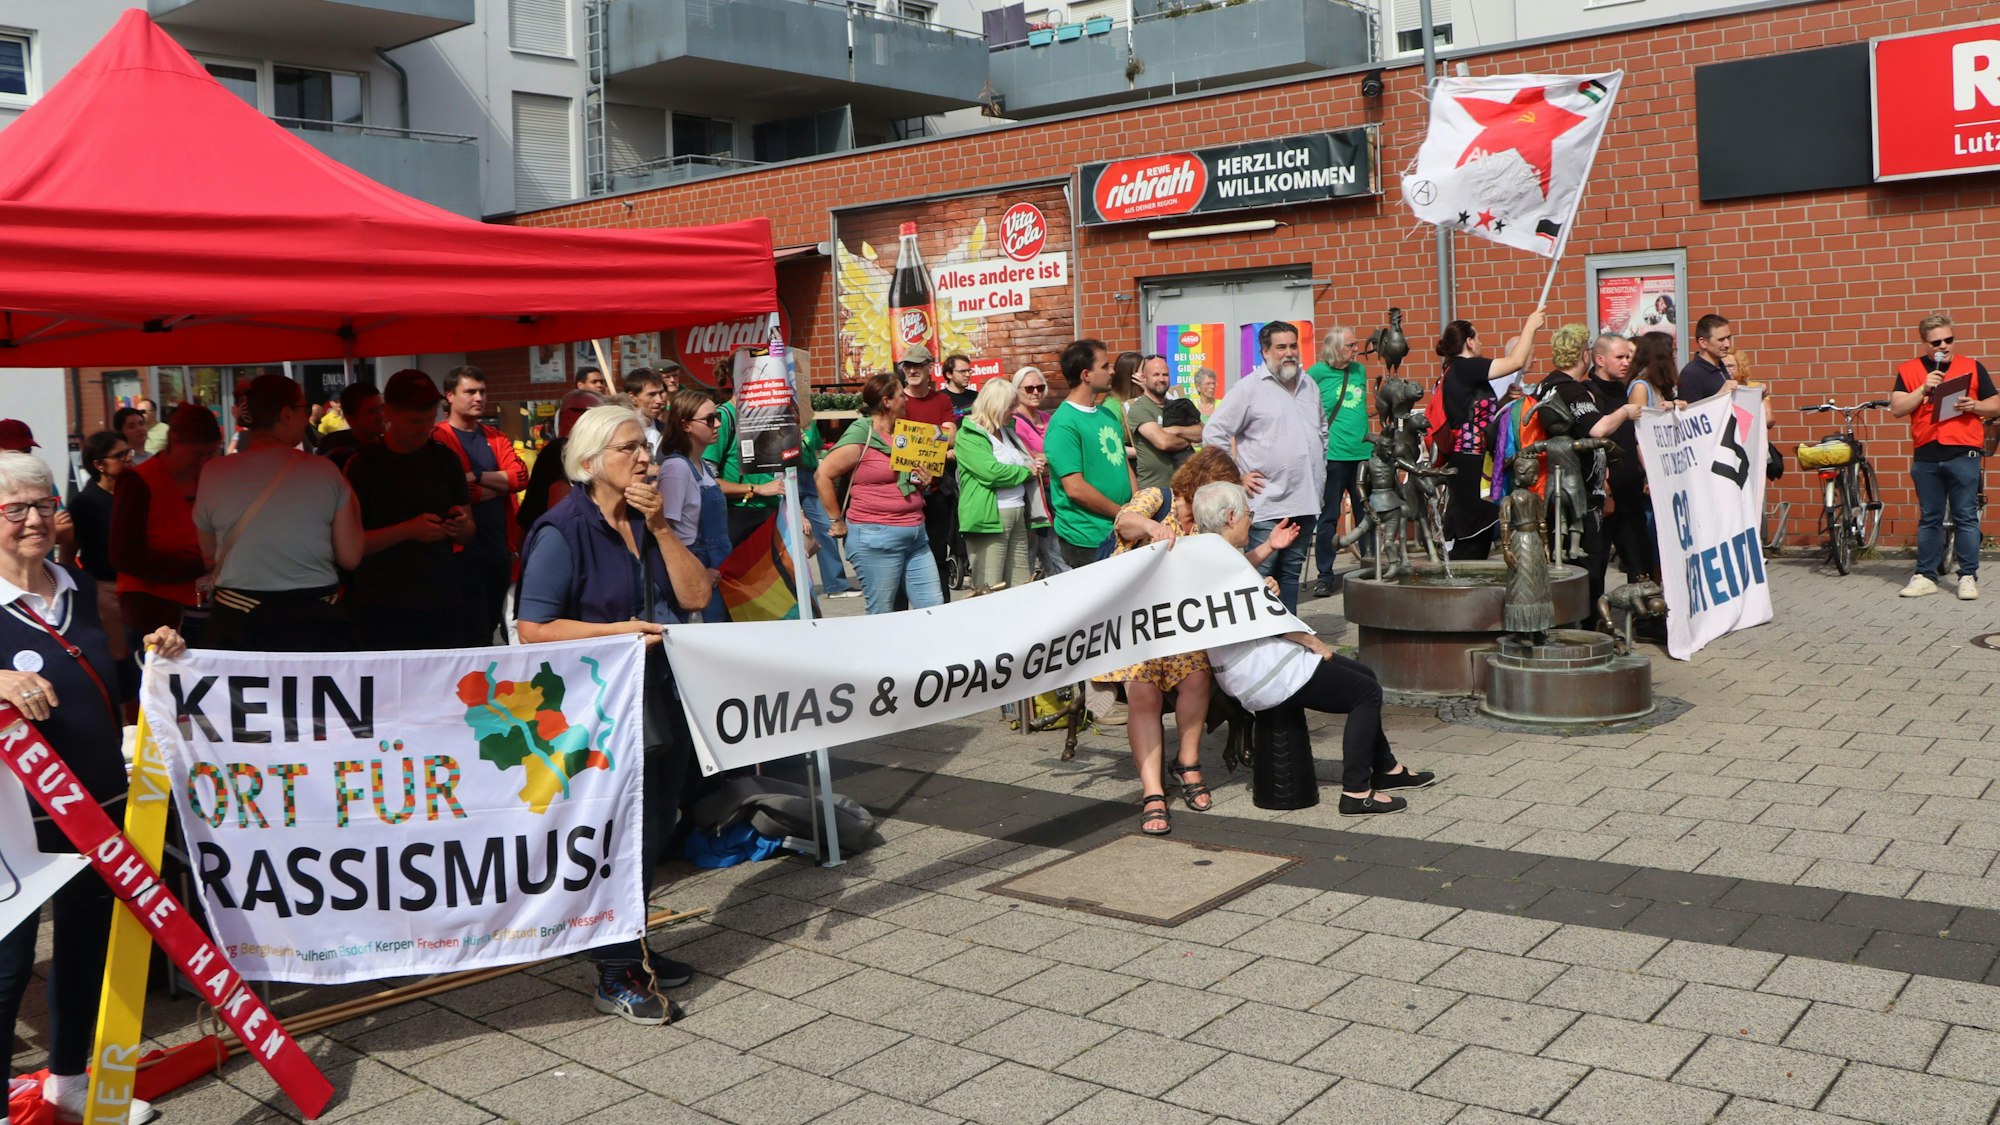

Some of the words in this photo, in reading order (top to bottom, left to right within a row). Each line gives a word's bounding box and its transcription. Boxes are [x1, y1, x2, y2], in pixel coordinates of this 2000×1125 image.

[1146, 163, 1171, 177] REWE
[1217, 147, 1309, 177] HERZLICH
[1105, 159, 1195, 209] richrath
[1217, 165, 1355, 198] WILLKOMMEN
[1124, 206, 1135, 214] AUS
[1135, 202, 1157, 211] DEINER
[1156, 198, 1178, 207] REGION
[1004, 211, 1037, 238] Vita
[1006, 225, 1044, 254] Cola
[938, 271, 975, 291] Alles
[979, 265, 1035, 286] andere
[1038, 260, 1060, 279] ist
[958, 296, 985, 312] nur
[988, 289, 1023, 309] Cola
[901, 312, 923, 330] Vita
[902, 323, 927, 341] Cola
[1174, 353, 1187, 361] BEI
[1189, 352, 1206, 360] UNS
[716, 683, 856, 744] OMAS
[869, 676, 898, 717] &
[914, 652, 1014, 708] OPAS
[1022, 616, 1122, 680] GEGEN
[1131, 585, 1288, 646] RECHTS
[169, 673, 374, 743] KEIN
[188, 761, 308, 828] ORT
[334, 739, 468, 828] FÜR
[197, 819, 613, 918] RASSISMUS!
[97, 836, 177, 928] OHNE
[187, 942, 286, 1060] HAKEN
[240, 943, 293, 958] Bergheim
[295, 948, 338, 962] Pulheim
[375, 939, 414, 953] Kerpen
[417, 937, 459, 949] Frechen
[568, 909, 614, 929] Wesseling
